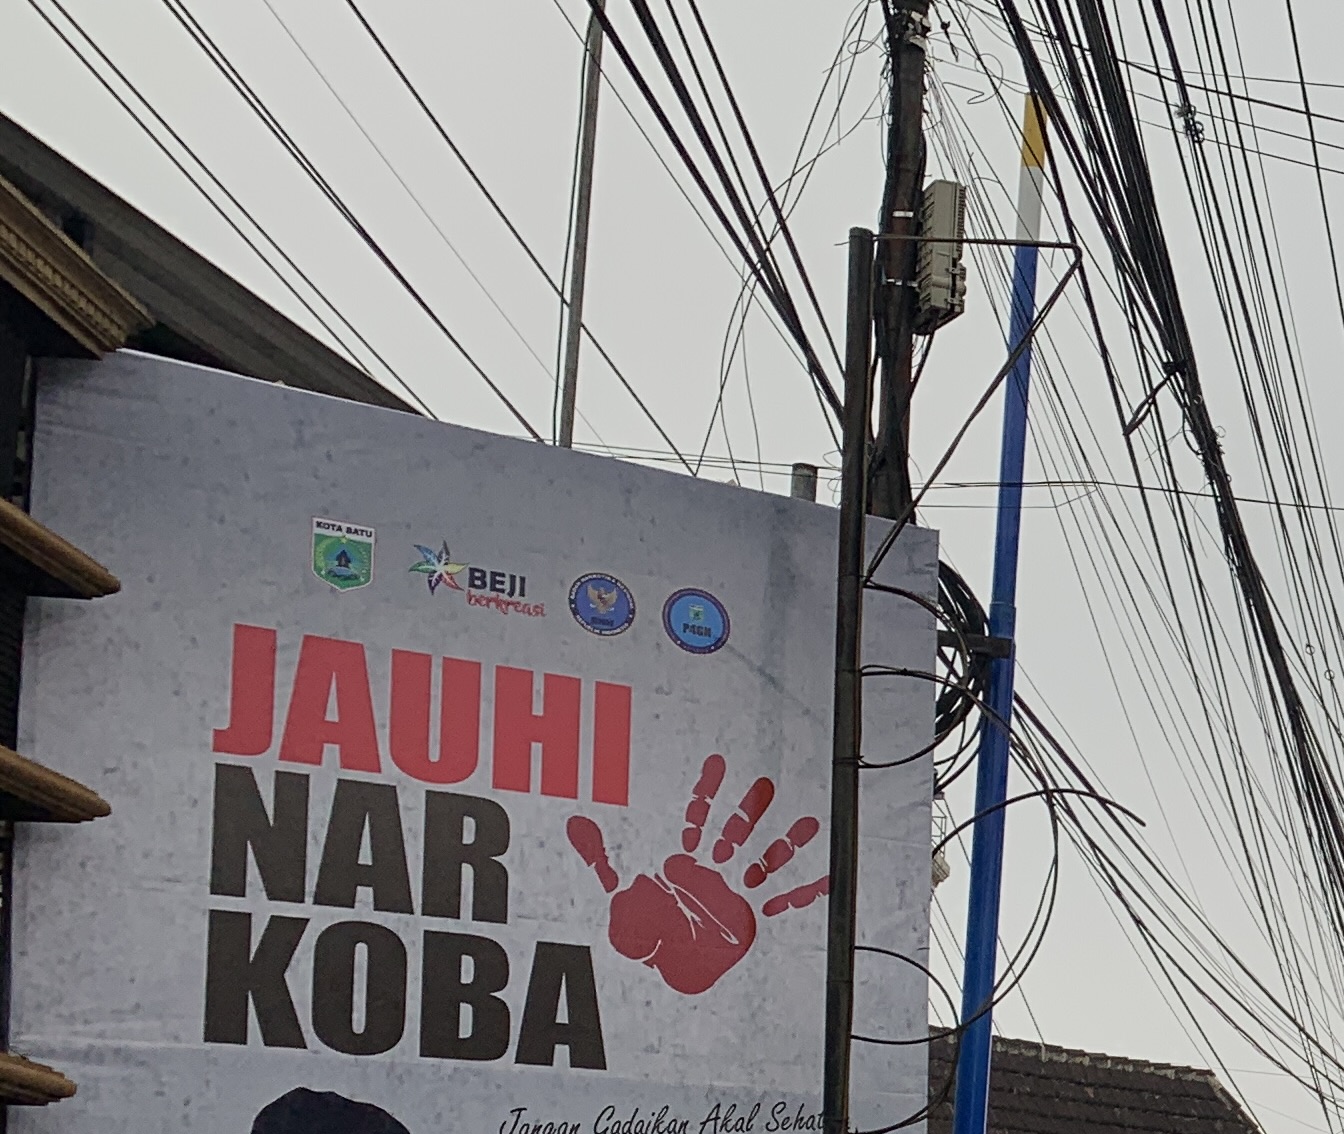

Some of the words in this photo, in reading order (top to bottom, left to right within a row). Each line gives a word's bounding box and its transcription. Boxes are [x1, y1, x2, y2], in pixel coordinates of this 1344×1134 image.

[315, 520, 343, 533] KOTA
[346, 525, 373, 538] BATU
[468, 566, 526, 598] BEJI
[466, 589, 547, 617] berkreasi
[213, 623, 632, 807] JAUHI
[210, 762, 511, 924] NAR
[203, 910, 607, 1071] KOBA
[765, 1101, 824, 1133] Sehat
